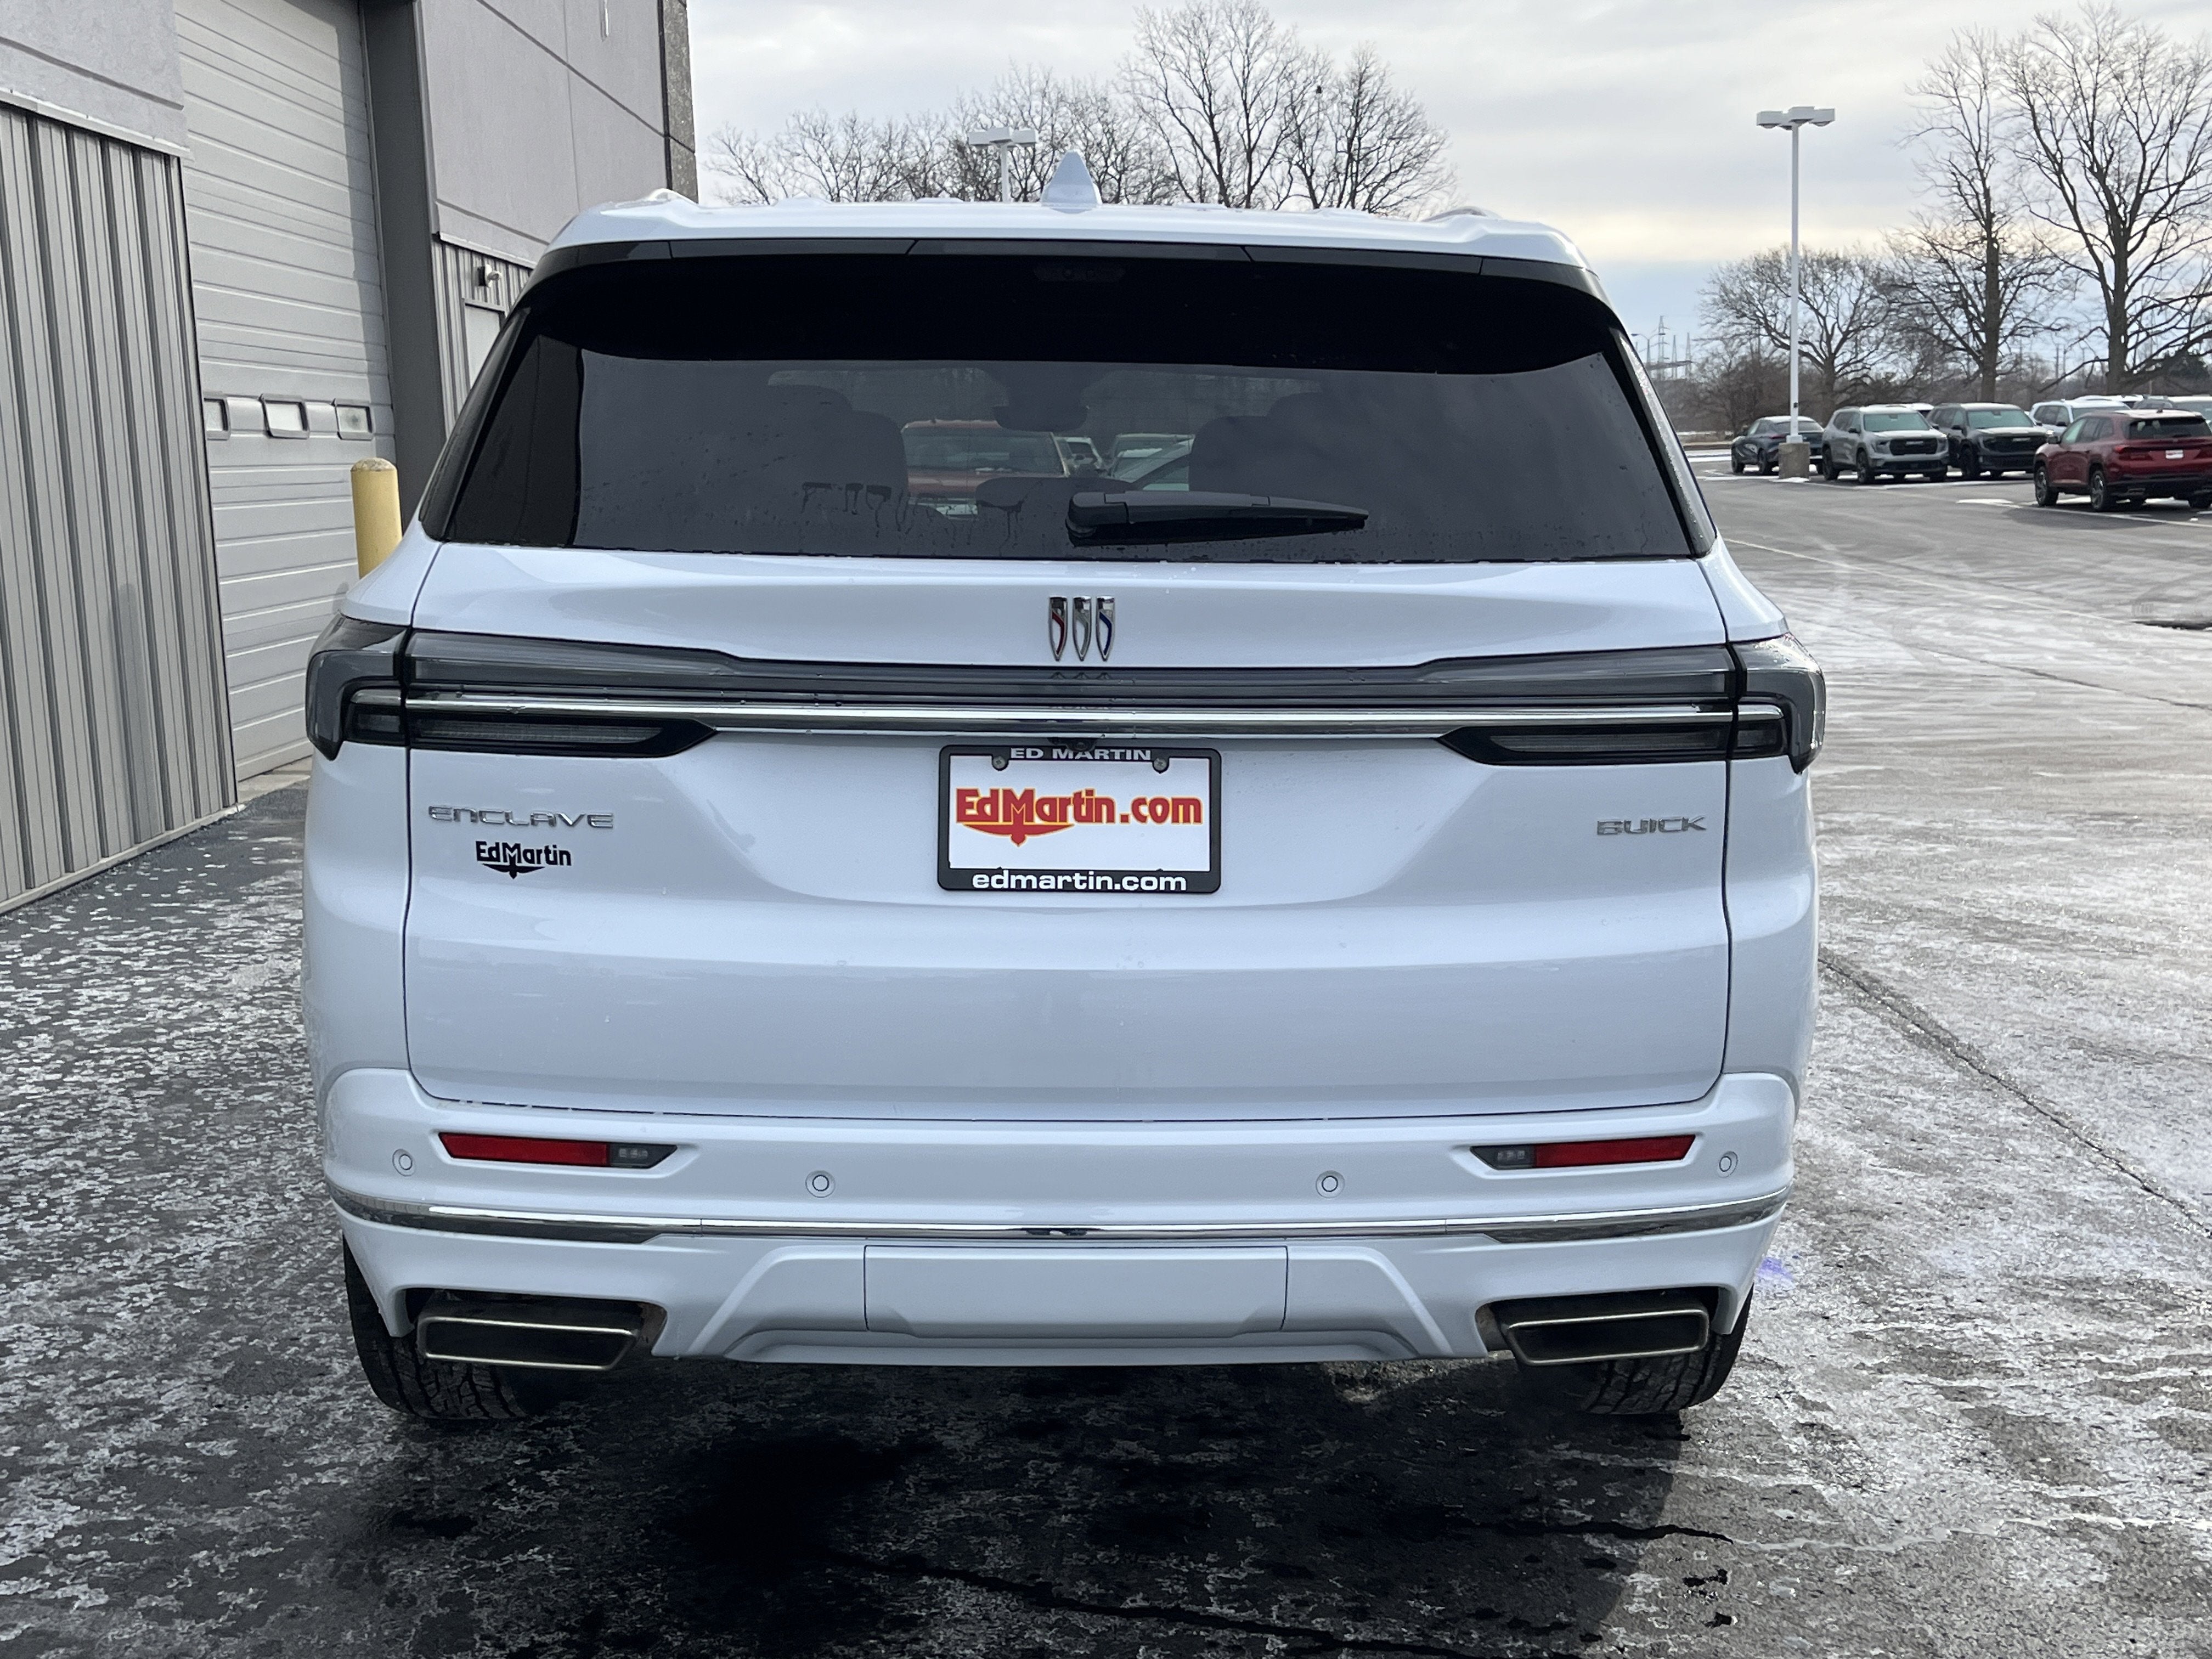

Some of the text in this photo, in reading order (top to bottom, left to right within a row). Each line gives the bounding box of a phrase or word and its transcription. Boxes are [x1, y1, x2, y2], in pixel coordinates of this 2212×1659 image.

[1011, 748, 1152, 760] ED MARTIN
[428, 805, 614, 828] ENCLAVE
[956, 788, 1203, 825] EdMartin.com
[1597, 816, 1707, 835] BUICK
[475, 840, 572, 866] EdMartin
[972, 870, 1187, 891] edmartin.com
